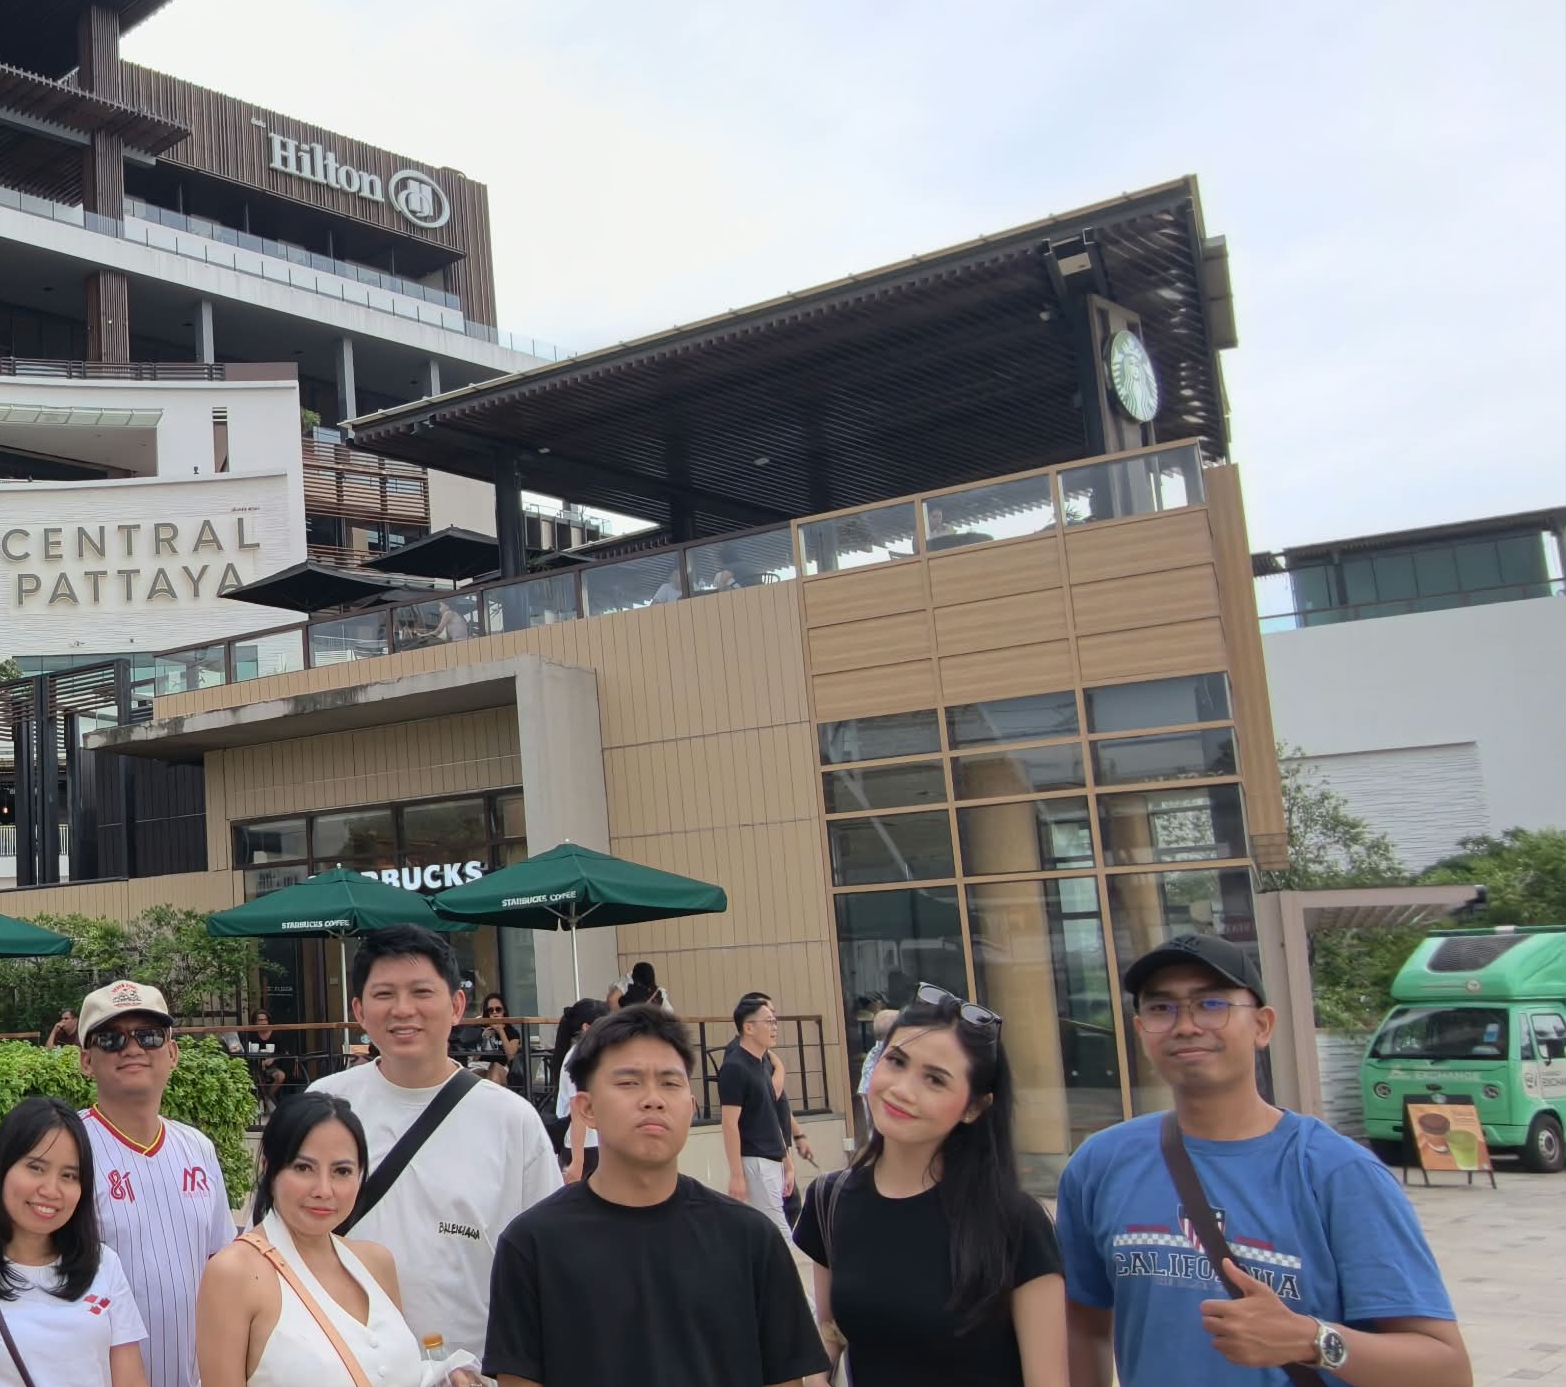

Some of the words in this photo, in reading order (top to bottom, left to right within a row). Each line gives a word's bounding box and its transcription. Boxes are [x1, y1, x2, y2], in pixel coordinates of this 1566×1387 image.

[268, 132, 384, 202] Hilton
[1, 517, 260, 561] CENTRAL
[17, 563, 243, 606] PATTAYA
[501, 894, 547, 907] STARBUCKS
[281, 920, 323, 929] STARBUCKS
[108, 1169, 136, 1204] 81
